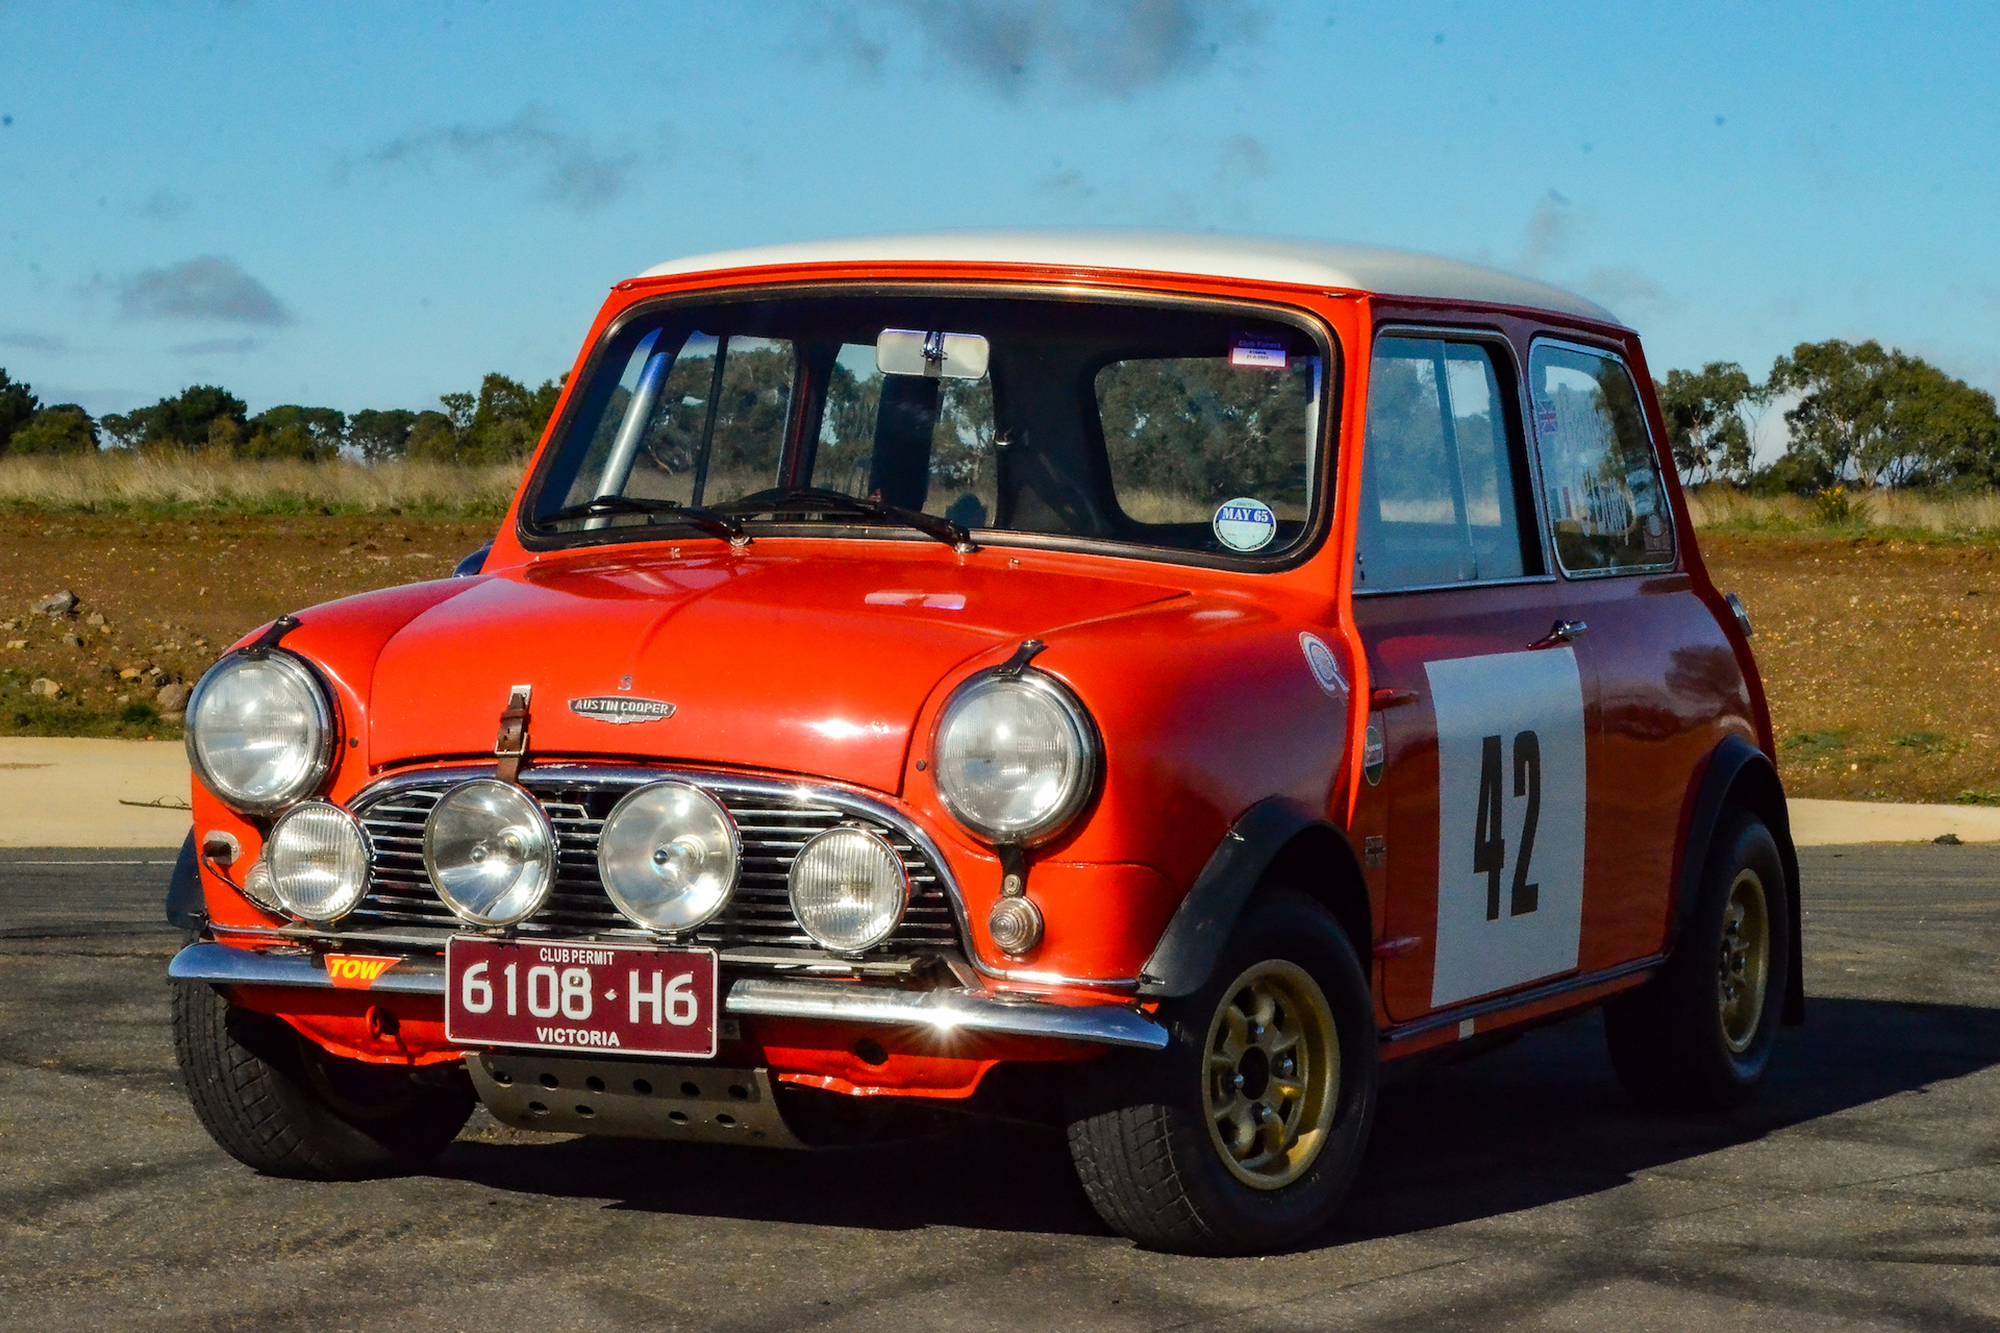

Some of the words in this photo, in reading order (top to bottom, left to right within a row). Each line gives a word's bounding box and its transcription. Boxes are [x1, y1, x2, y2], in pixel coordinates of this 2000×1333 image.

[1222, 507, 1252, 521] MAY
[1253, 510, 1269, 522] 65
[617, 674, 634, 691] S
[575, 699, 619, 711] AUSTIN
[620, 701, 669, 714] COOPER
[1473, 730, 1541, 921] 42
[540, 948, 570, 964] CLUB
[571, 950, 615, 966] PERMIT
[329, 958, 387, 980] TOW
[536, 1026, 620, 1047] VICTORIA
